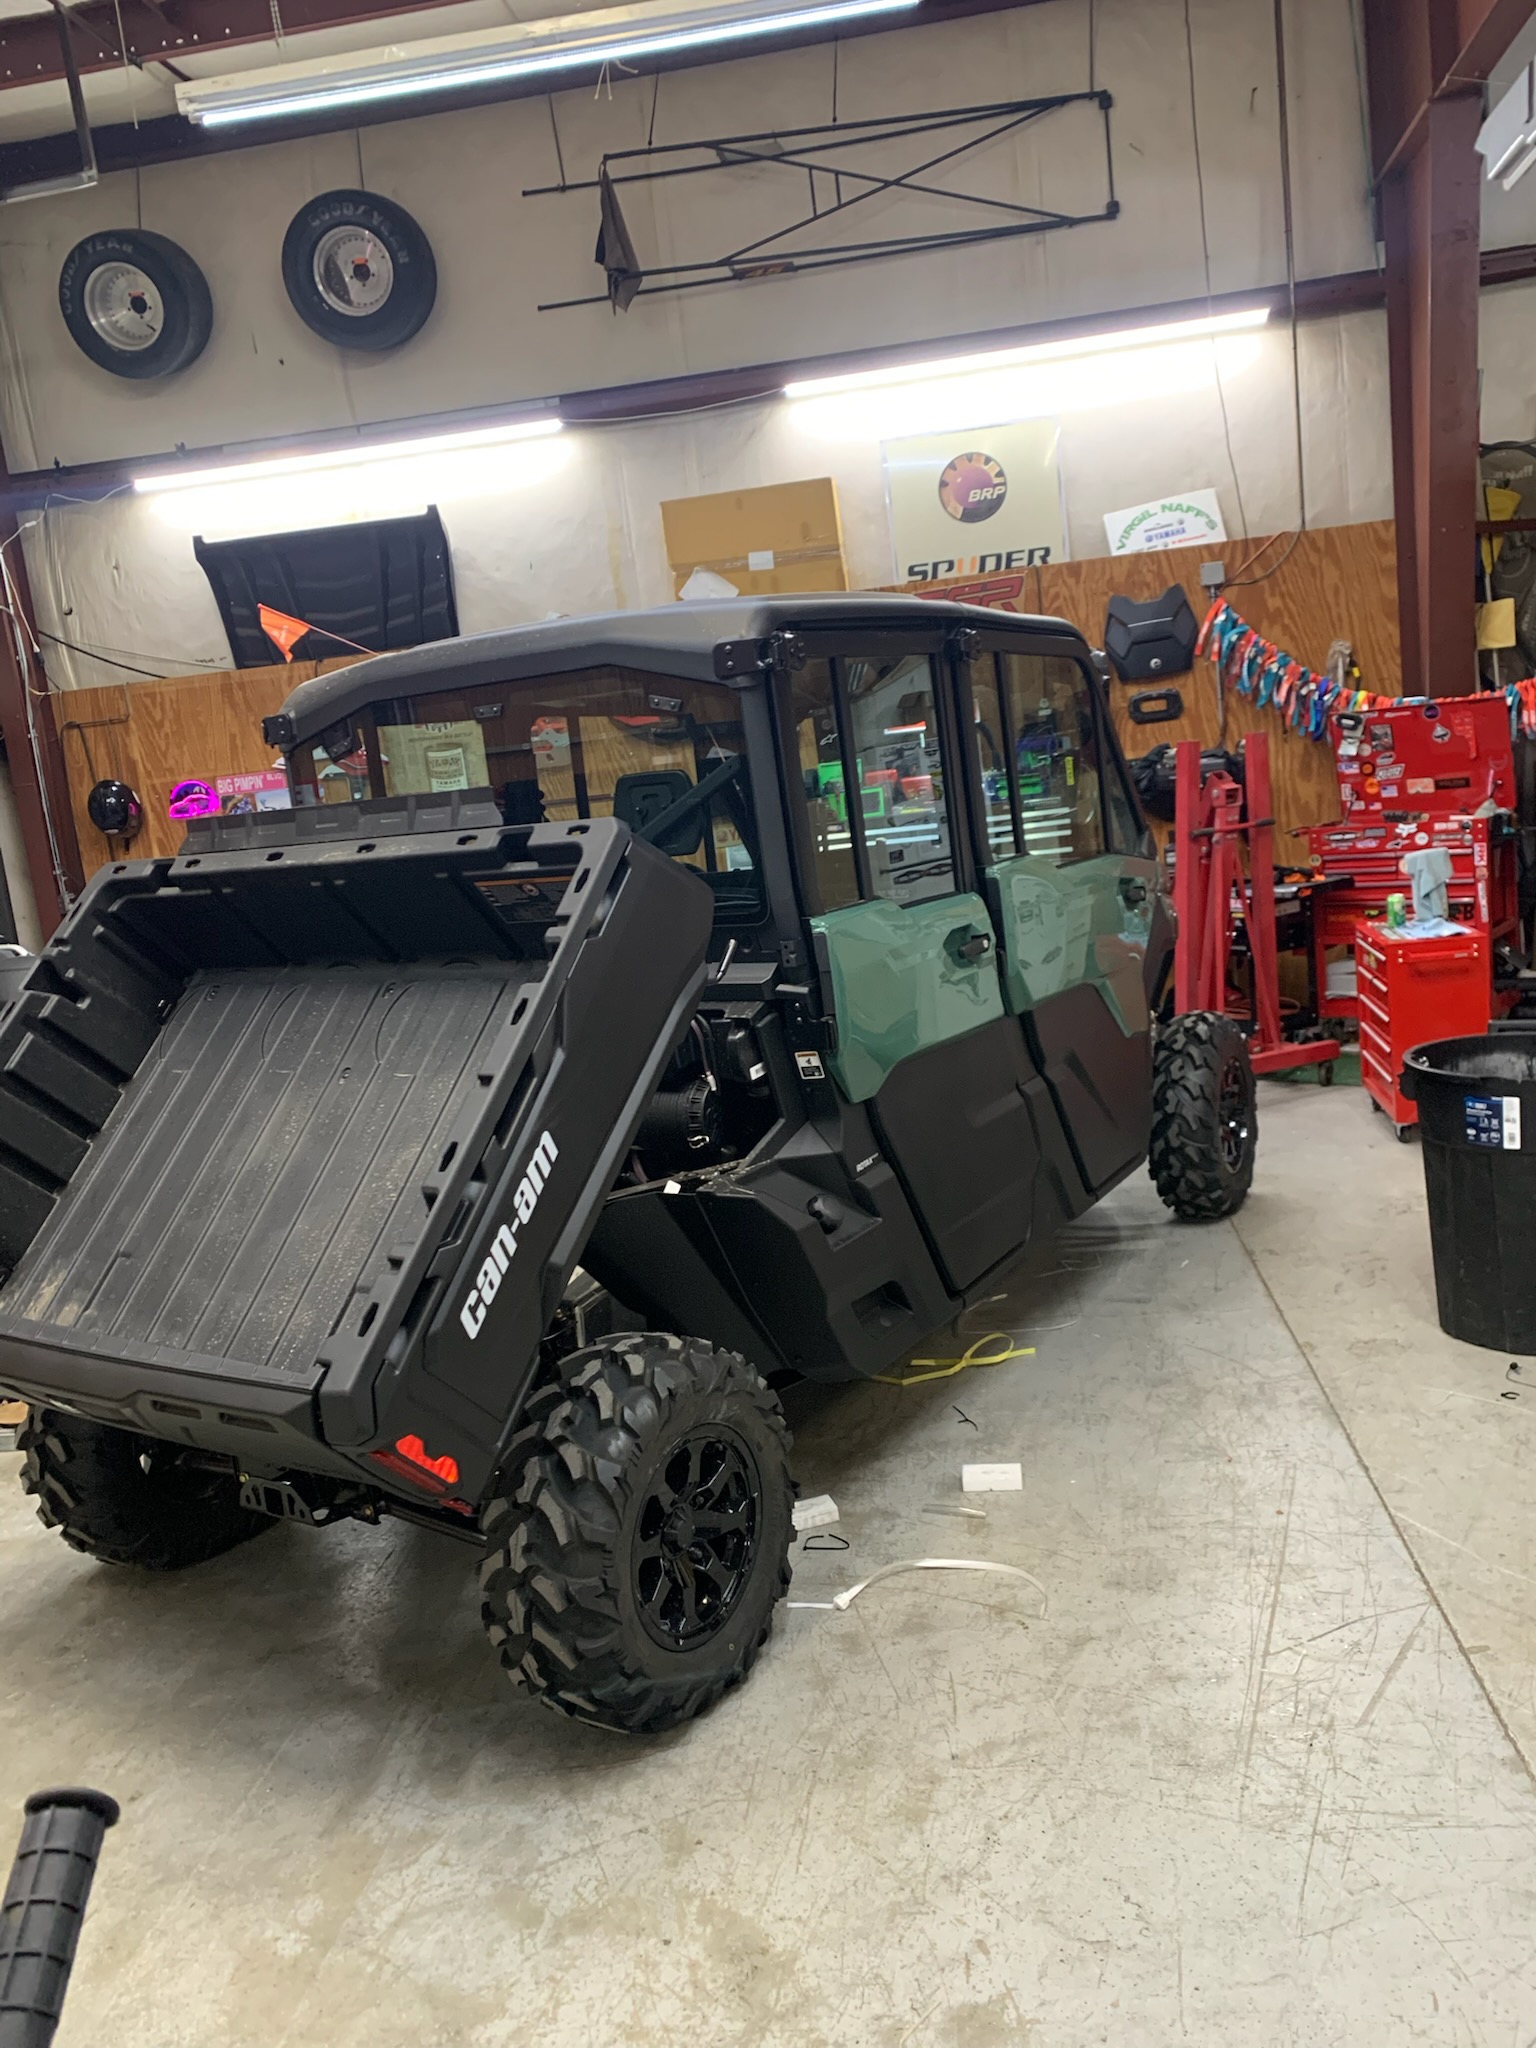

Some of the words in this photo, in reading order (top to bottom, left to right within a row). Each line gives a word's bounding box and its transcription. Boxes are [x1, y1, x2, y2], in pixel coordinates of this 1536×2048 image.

[968, 485, 1006, 503] BRP
[1116, 509, 1158, 551] VIRGIL
[1154, 527, 1187, 541] YAMAHA
[217, 778, 233, 793] BIG
[460, 1130, 560, 1341] can-am
